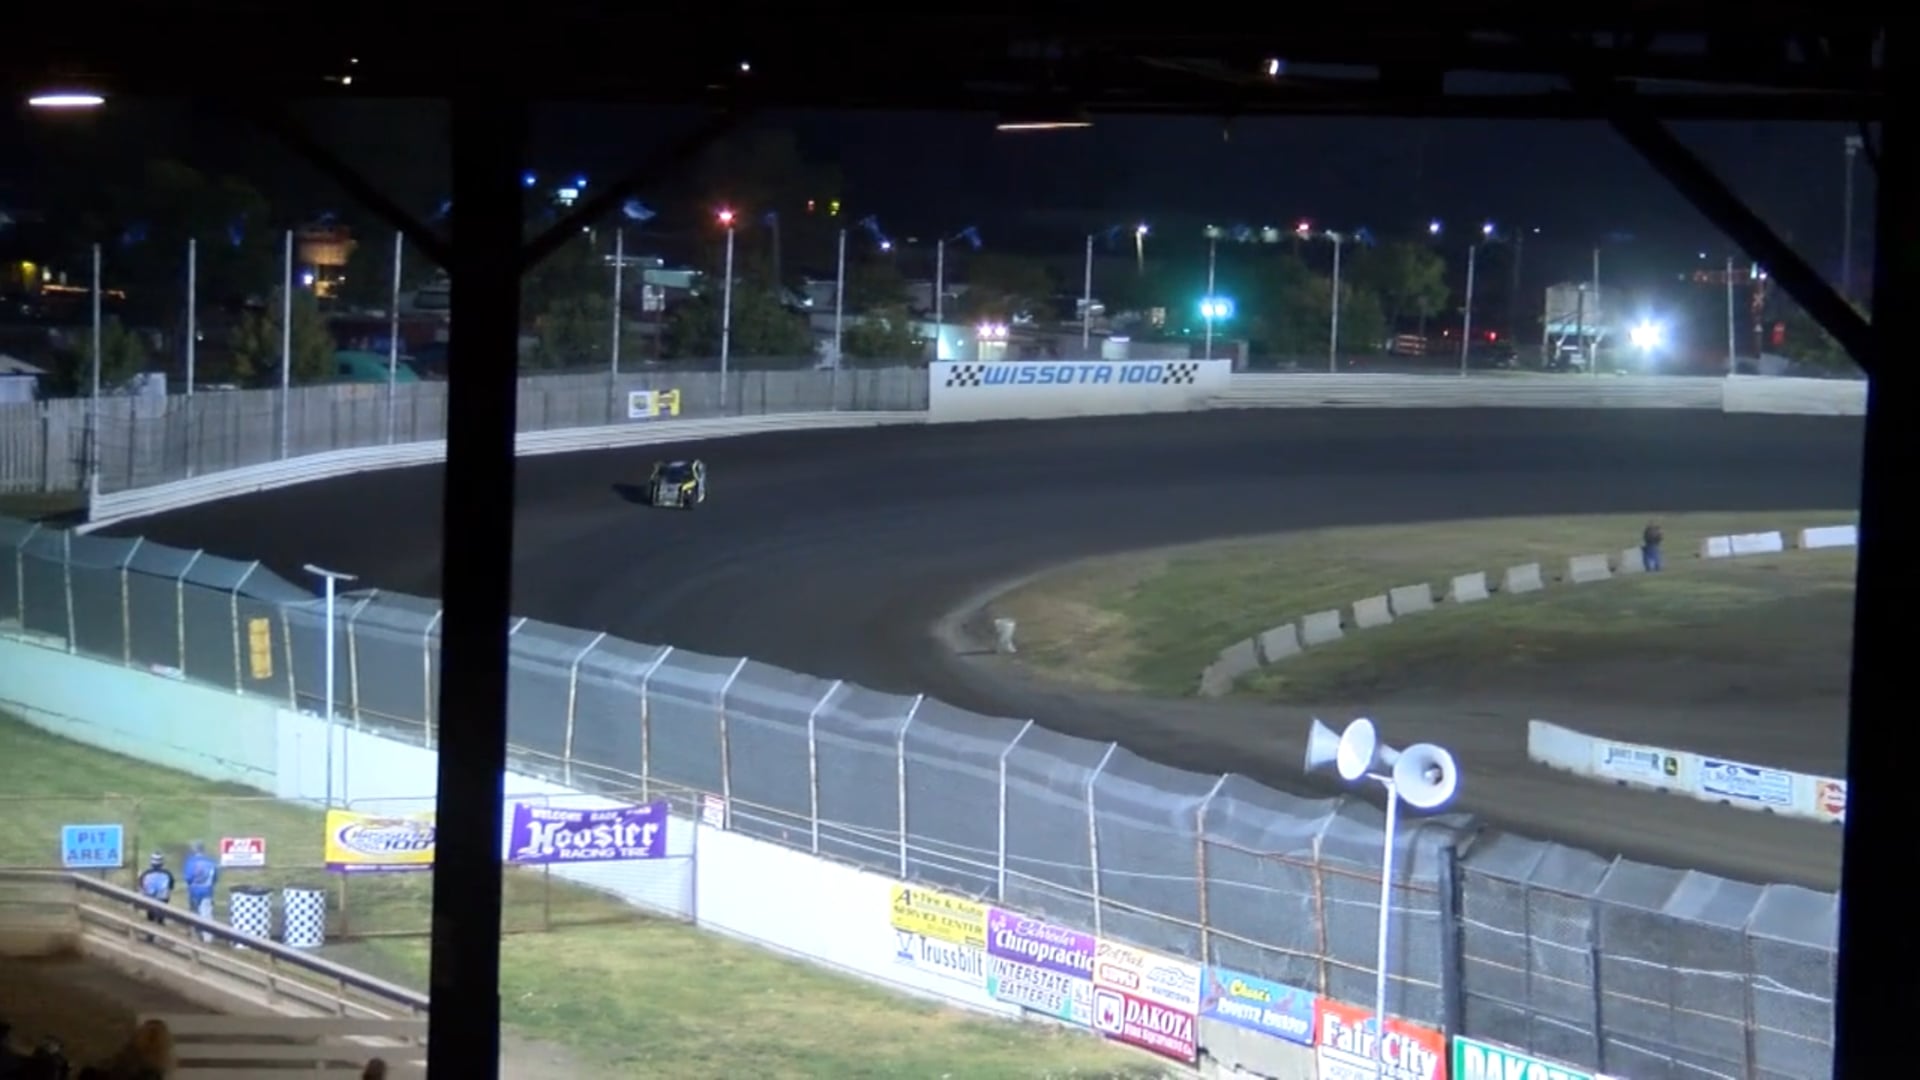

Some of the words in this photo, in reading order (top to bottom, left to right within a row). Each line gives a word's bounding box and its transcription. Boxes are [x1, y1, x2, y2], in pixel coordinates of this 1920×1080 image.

[984, 365, 1112, 385] WISSOTA
[1118, 365, 1163, 385] 100
[78, 832, 106, 843] PIT
[517, 817, 660, 856] Hoosier
[560, 848, 615, 858] RACING
[620, 846, 650, 857] TIRE
[67, 848, 118, 861] AREA
[941, 916, 984, 934] CENTER
[918, 935, 984, 977] Trussbilt
[996, 931, 1095, 972] Chiropractic
[993, 959, 1070, 995] INTERSTATE
[999, 980, 1062, 1011] BATTERIES
[1126, 999, 1194, 1041] DAKOTA
[1322, 1013, 1377, 1058] Fair
[1381, 1032, 1438, 1078] City
